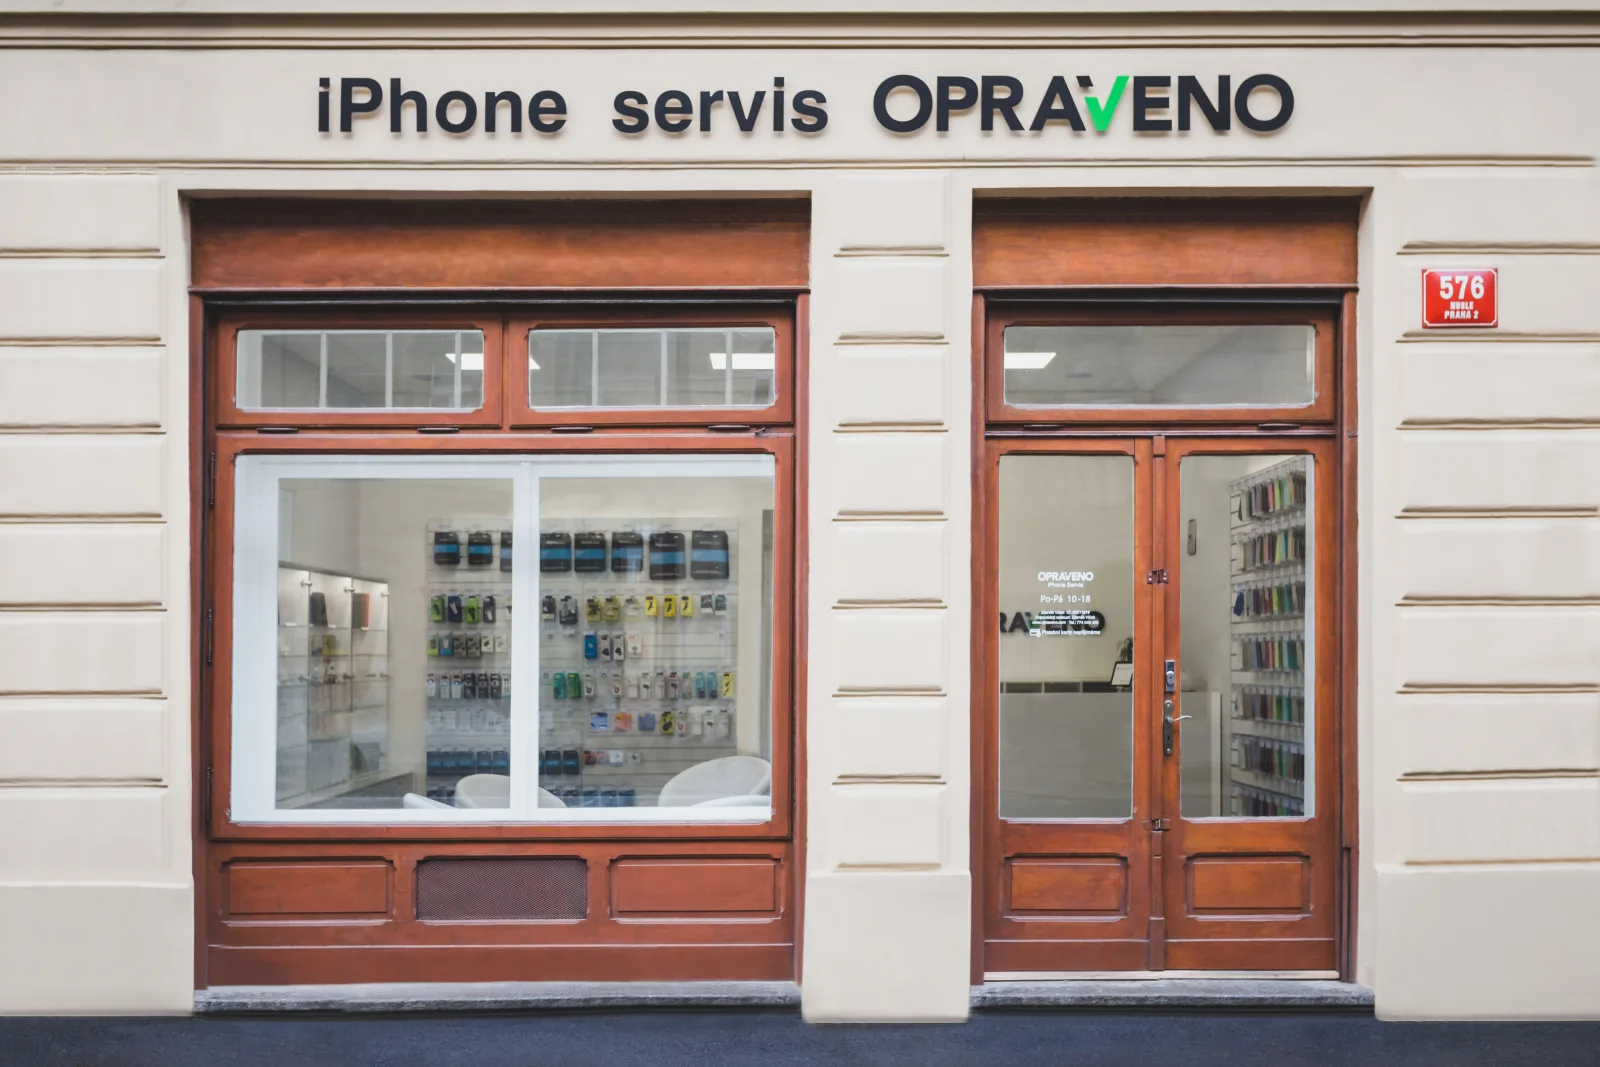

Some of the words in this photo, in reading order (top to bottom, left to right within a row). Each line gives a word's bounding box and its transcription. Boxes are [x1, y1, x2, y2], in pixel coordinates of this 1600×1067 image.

[318, 77, 568, 133] iPhone
[611, 77, 829, 133] servis
[872, 73, 1295, 133] OPRAVENO
[1439, 275, 1485, 300] 576
[1450, 301, 1474, 310] NUSLE
[1444, 310, 1471, 320] PRAHA
[1473, 310, 1479, 319] 2
[1037, 571, 1094, 582] OPRAVENO
